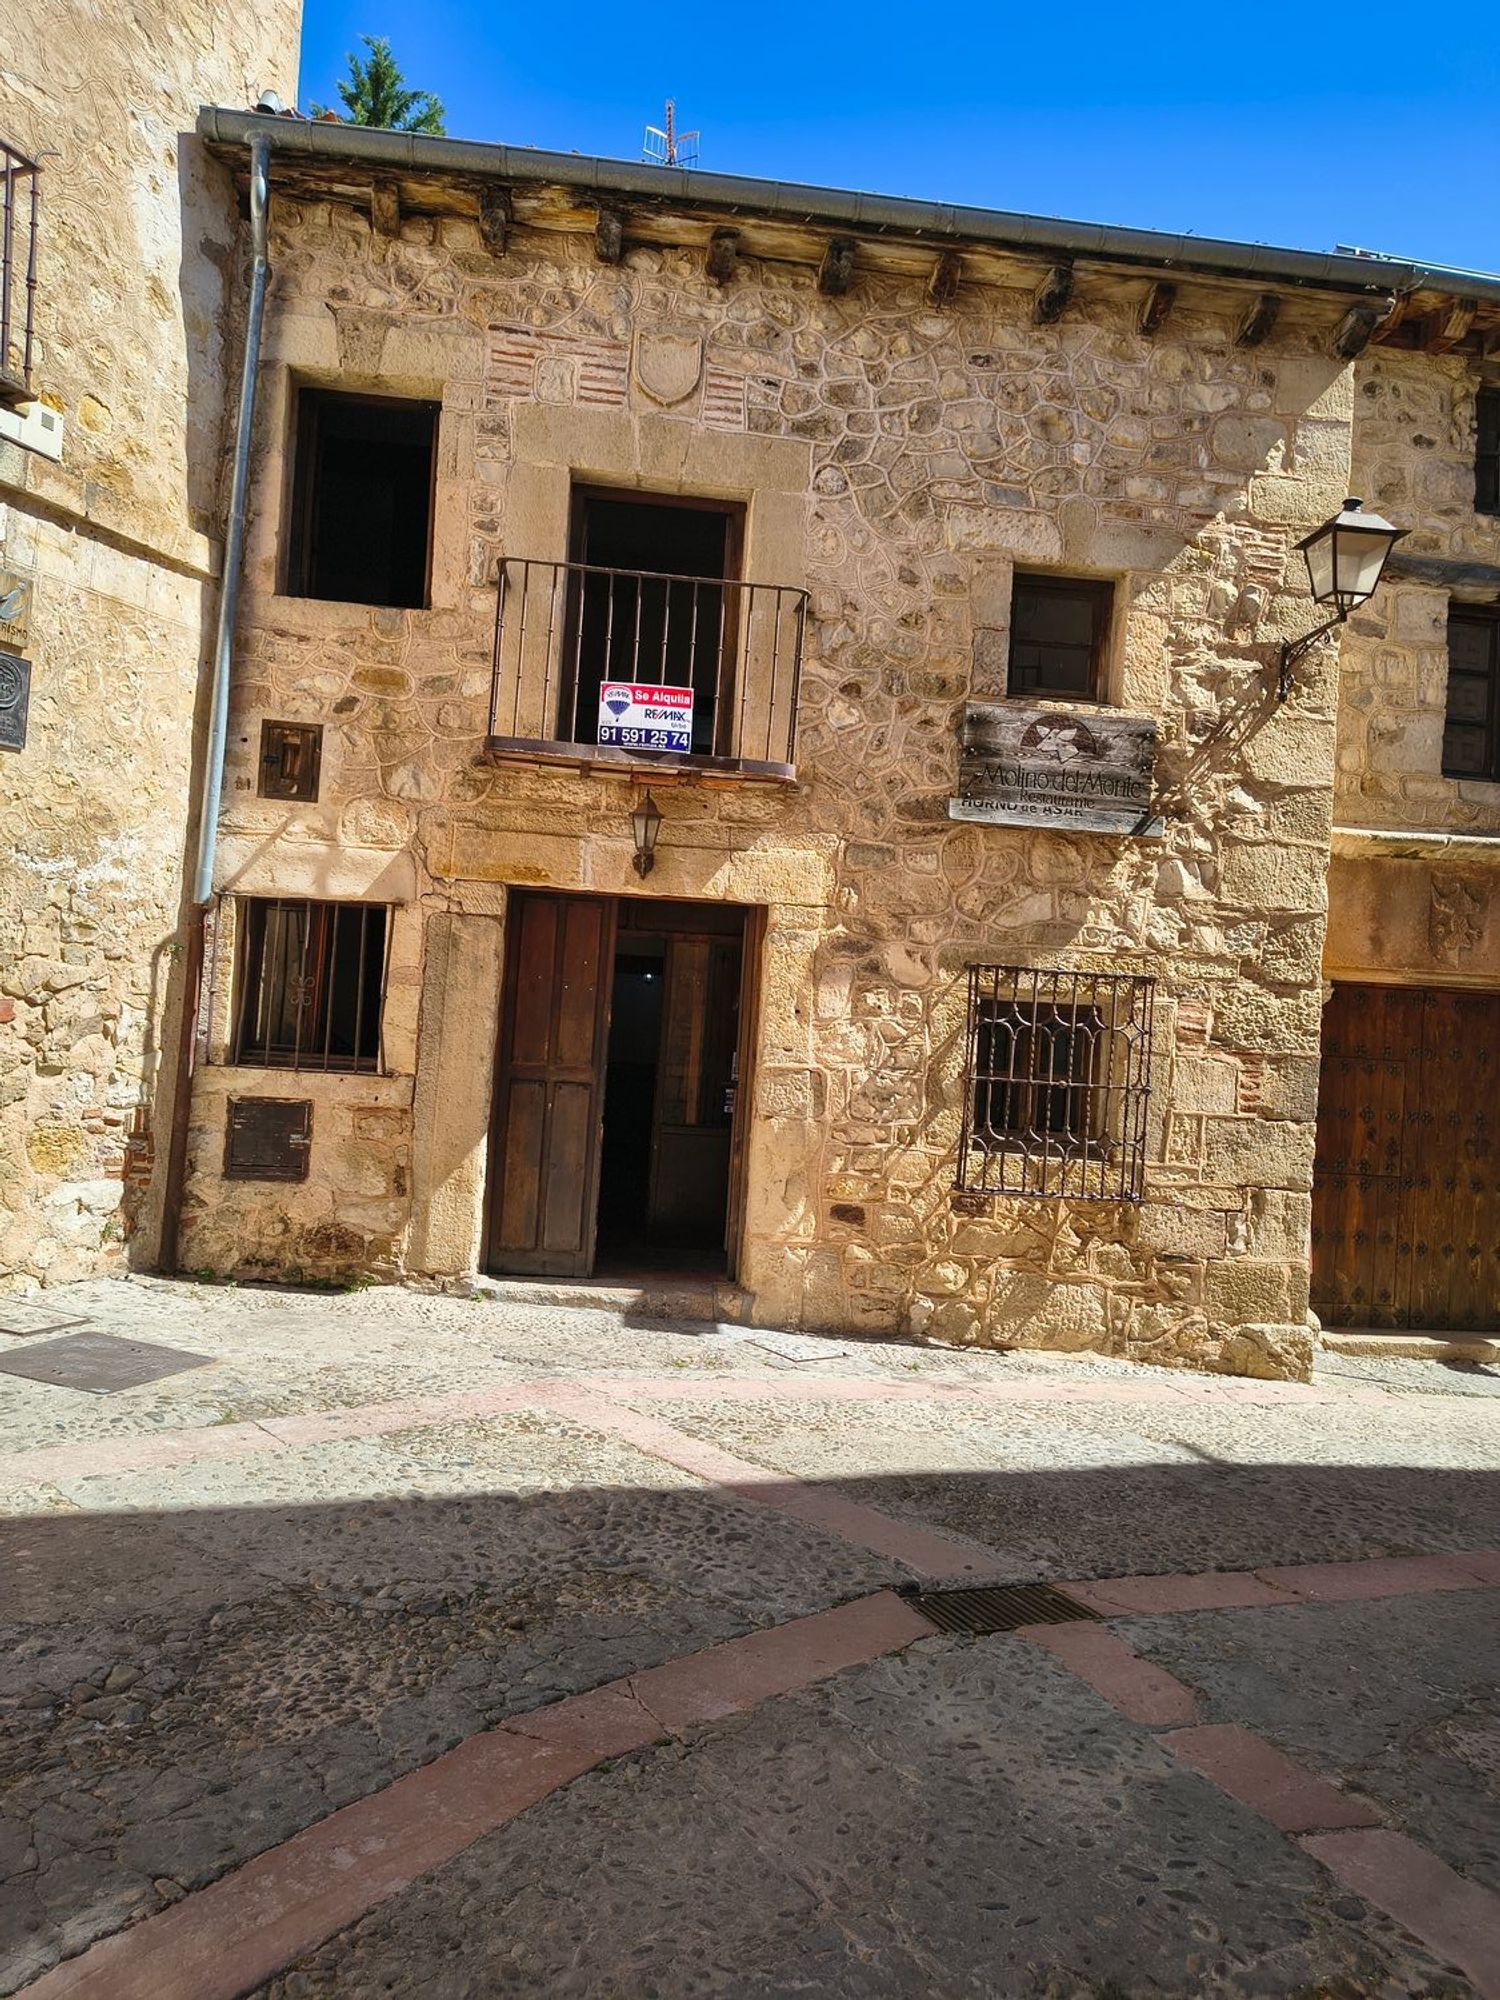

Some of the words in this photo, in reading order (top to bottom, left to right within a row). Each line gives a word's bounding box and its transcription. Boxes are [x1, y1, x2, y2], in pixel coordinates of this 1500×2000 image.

[635, 689, 649, 701] Se
[652, 692, 690, 704] Alquila
[644, 708, 686, 721] RE/MAX
[601, 727, 616, 740] 91
[621, 729, 646, 742] 591
[650, 731, 668, 744] 25
[671, 733, 688, 746] 74
[978, 763, 1050, 790] Molino
[1053, 768, 1079, 793] del
[1080, 771, 1143, 799] Monte
[1020, 788, 1095, 809] Restaurante
